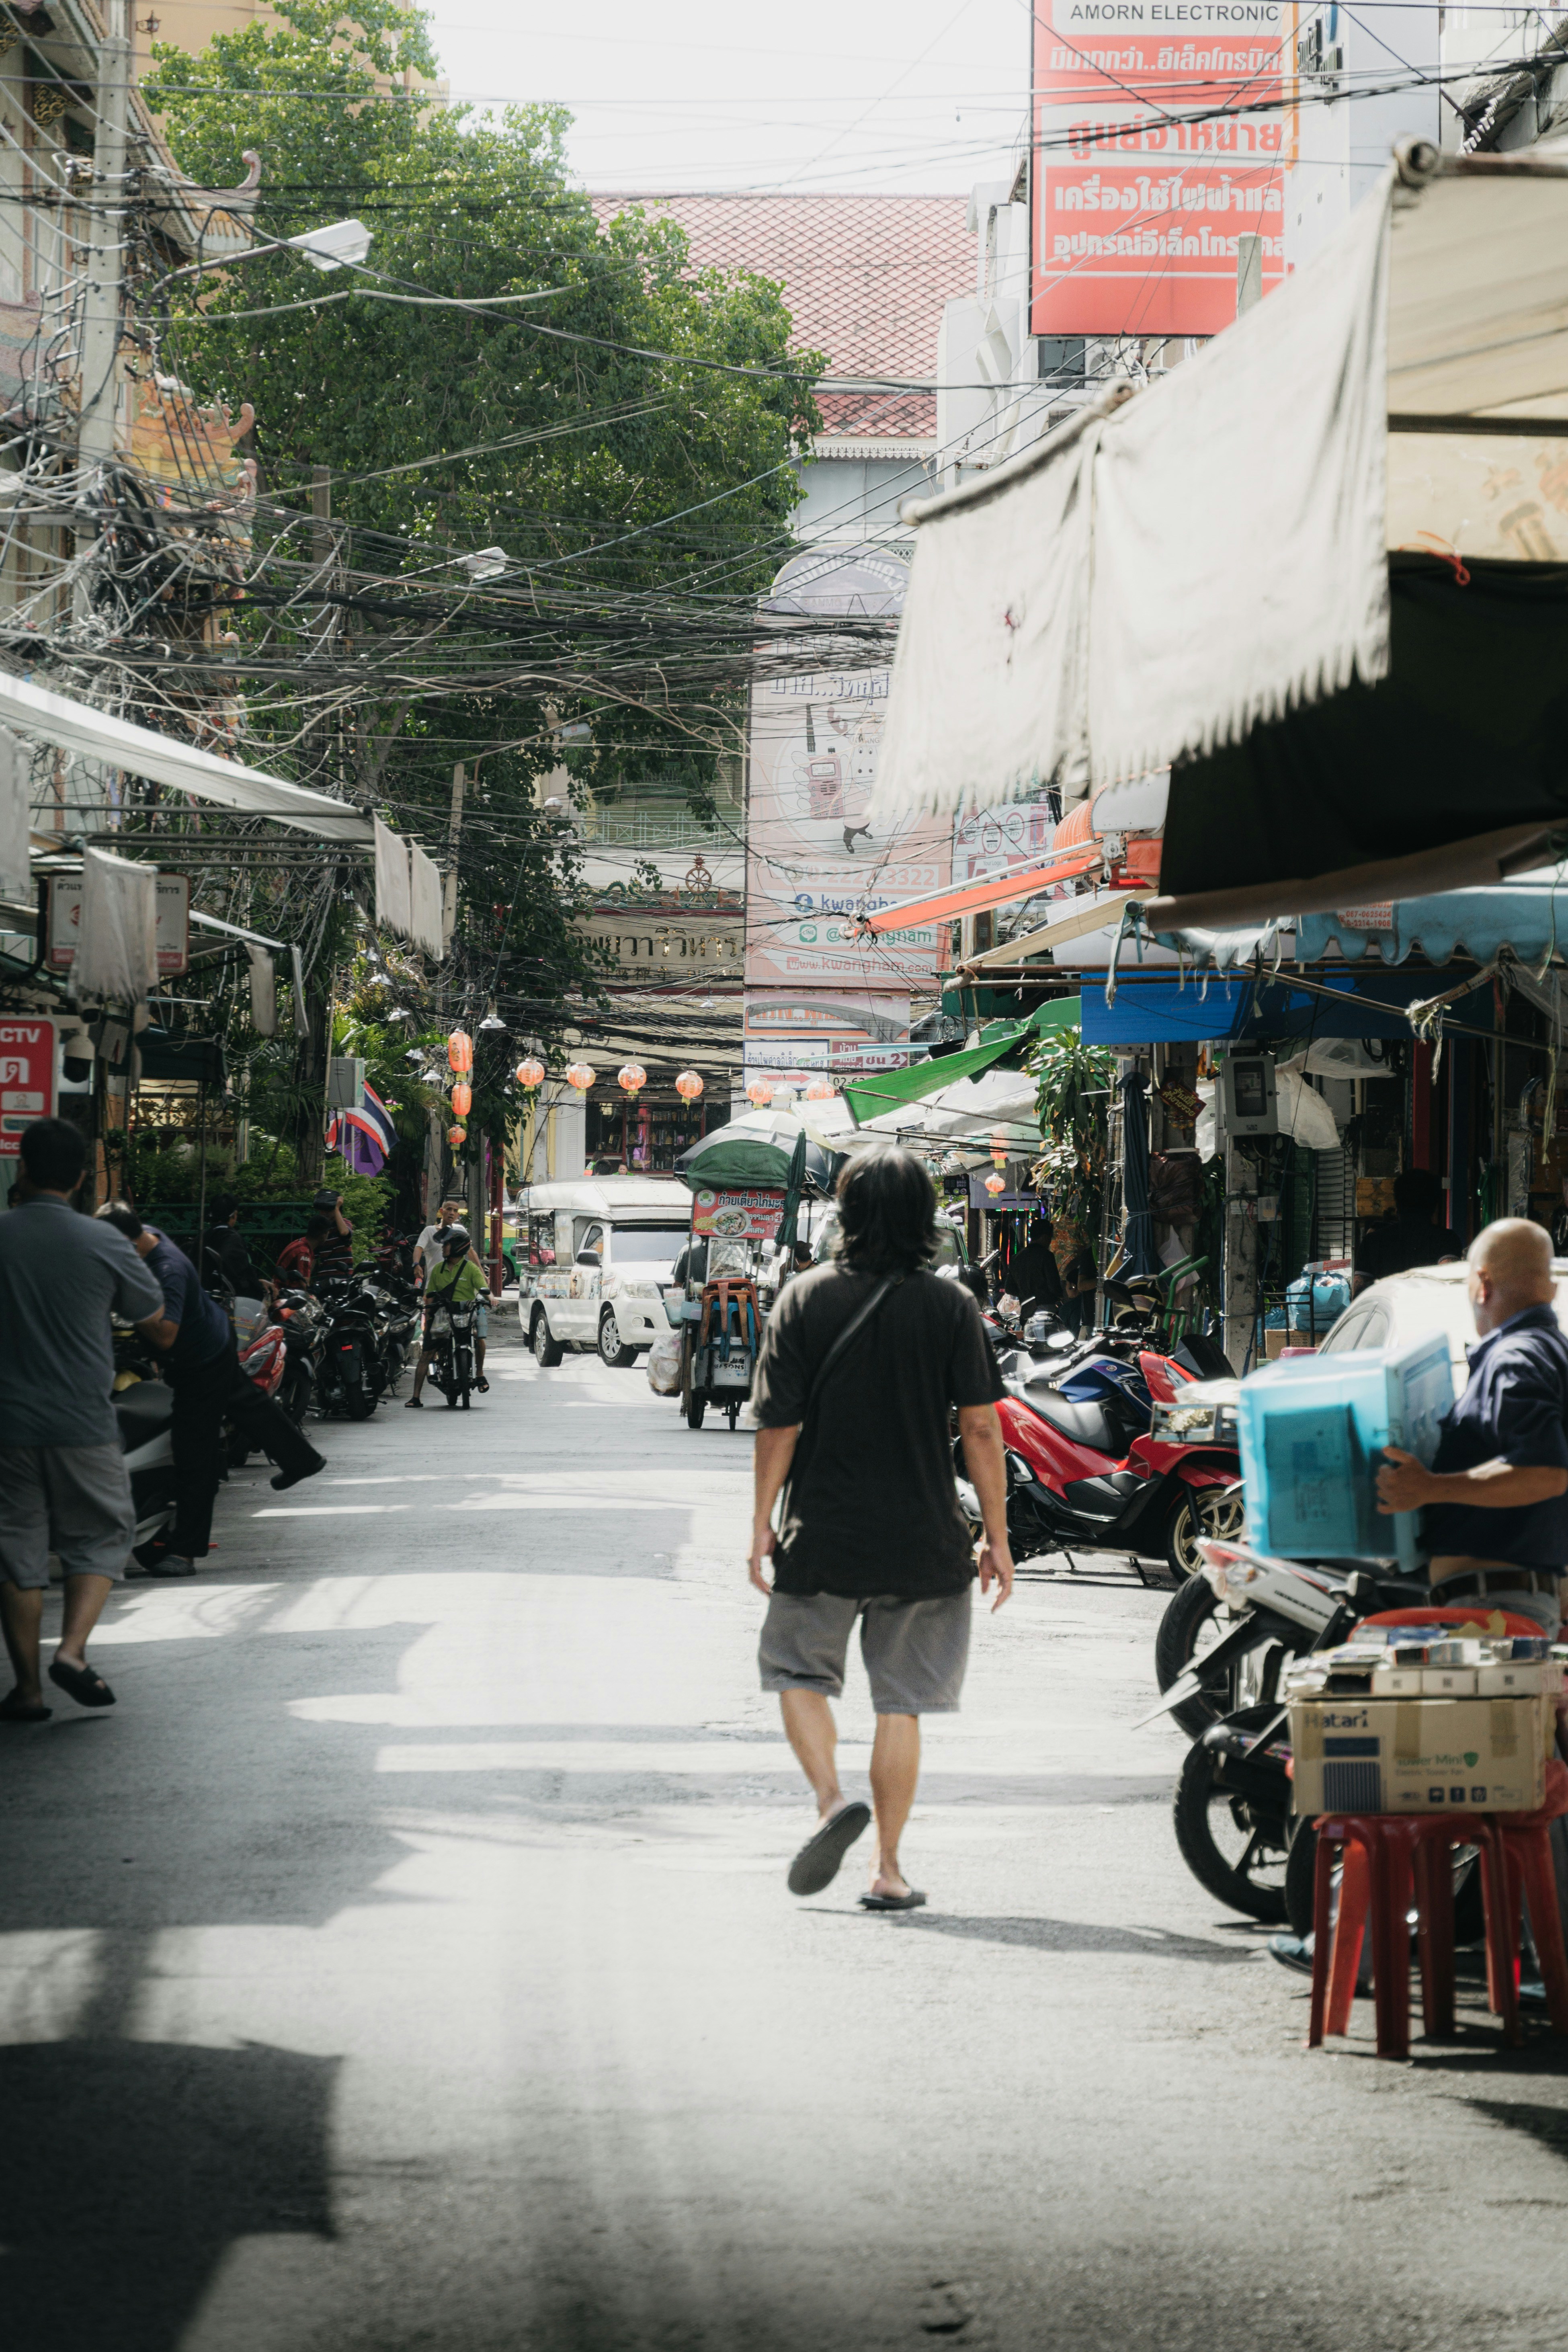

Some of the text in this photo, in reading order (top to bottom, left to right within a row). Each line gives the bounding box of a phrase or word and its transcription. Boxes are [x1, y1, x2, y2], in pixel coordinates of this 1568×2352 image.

[1070, 4, 1279, 21] AMORN ELECTRONIC
[1050, 44, 1284, 71] มีมากกว่า..อีเล็คโทรนิค
[1055, 174, 1284, 211] เครื่องใช้ไฟฟ้าแล
[839, 1042, 857, 1053] บ้าน
[890, 1053, 900, 1064] 2
[1305, 1709, 1368, 1728] Hatari
